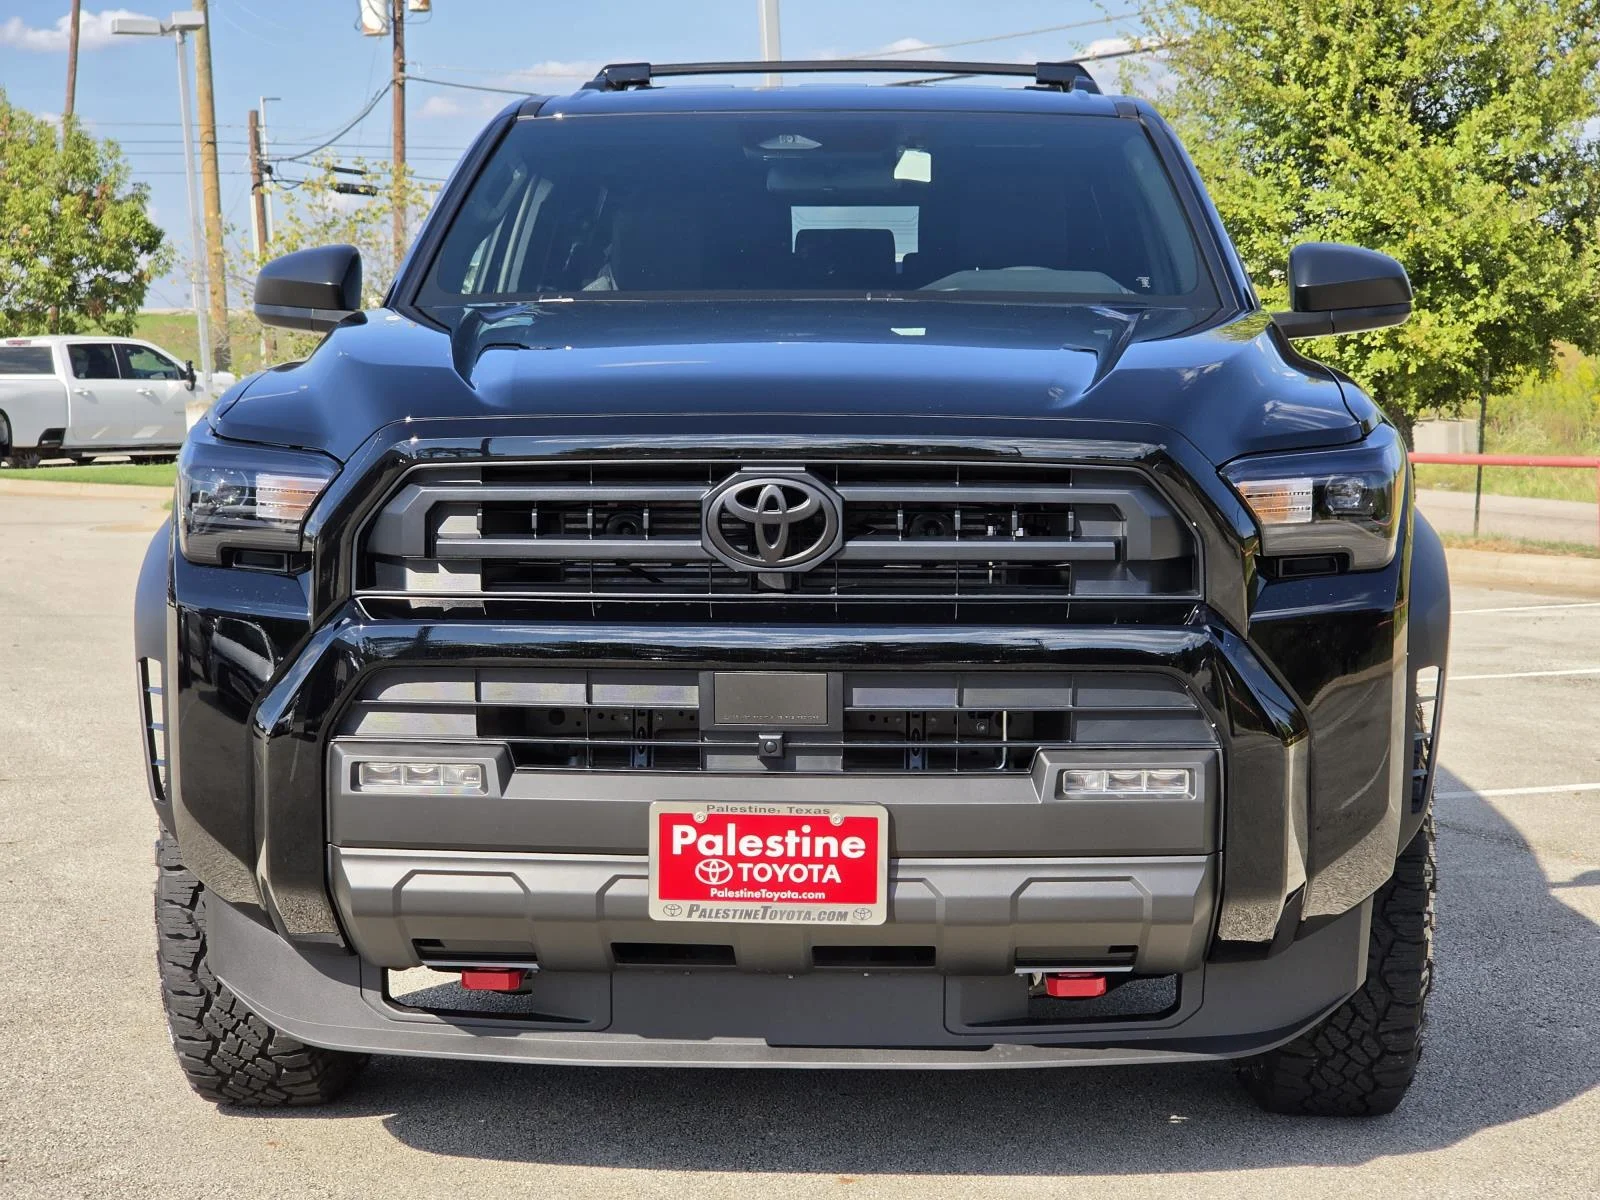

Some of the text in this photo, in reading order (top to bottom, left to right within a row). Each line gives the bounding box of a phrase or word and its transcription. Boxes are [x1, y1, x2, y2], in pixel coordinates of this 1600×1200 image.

[786, 806, 831, 815] Texas
[672, 823, 866, 858] Palestine
[737, 863, 842, 884] TOYOTA
[710, 887, 826, 901] PalestineToyota.com
